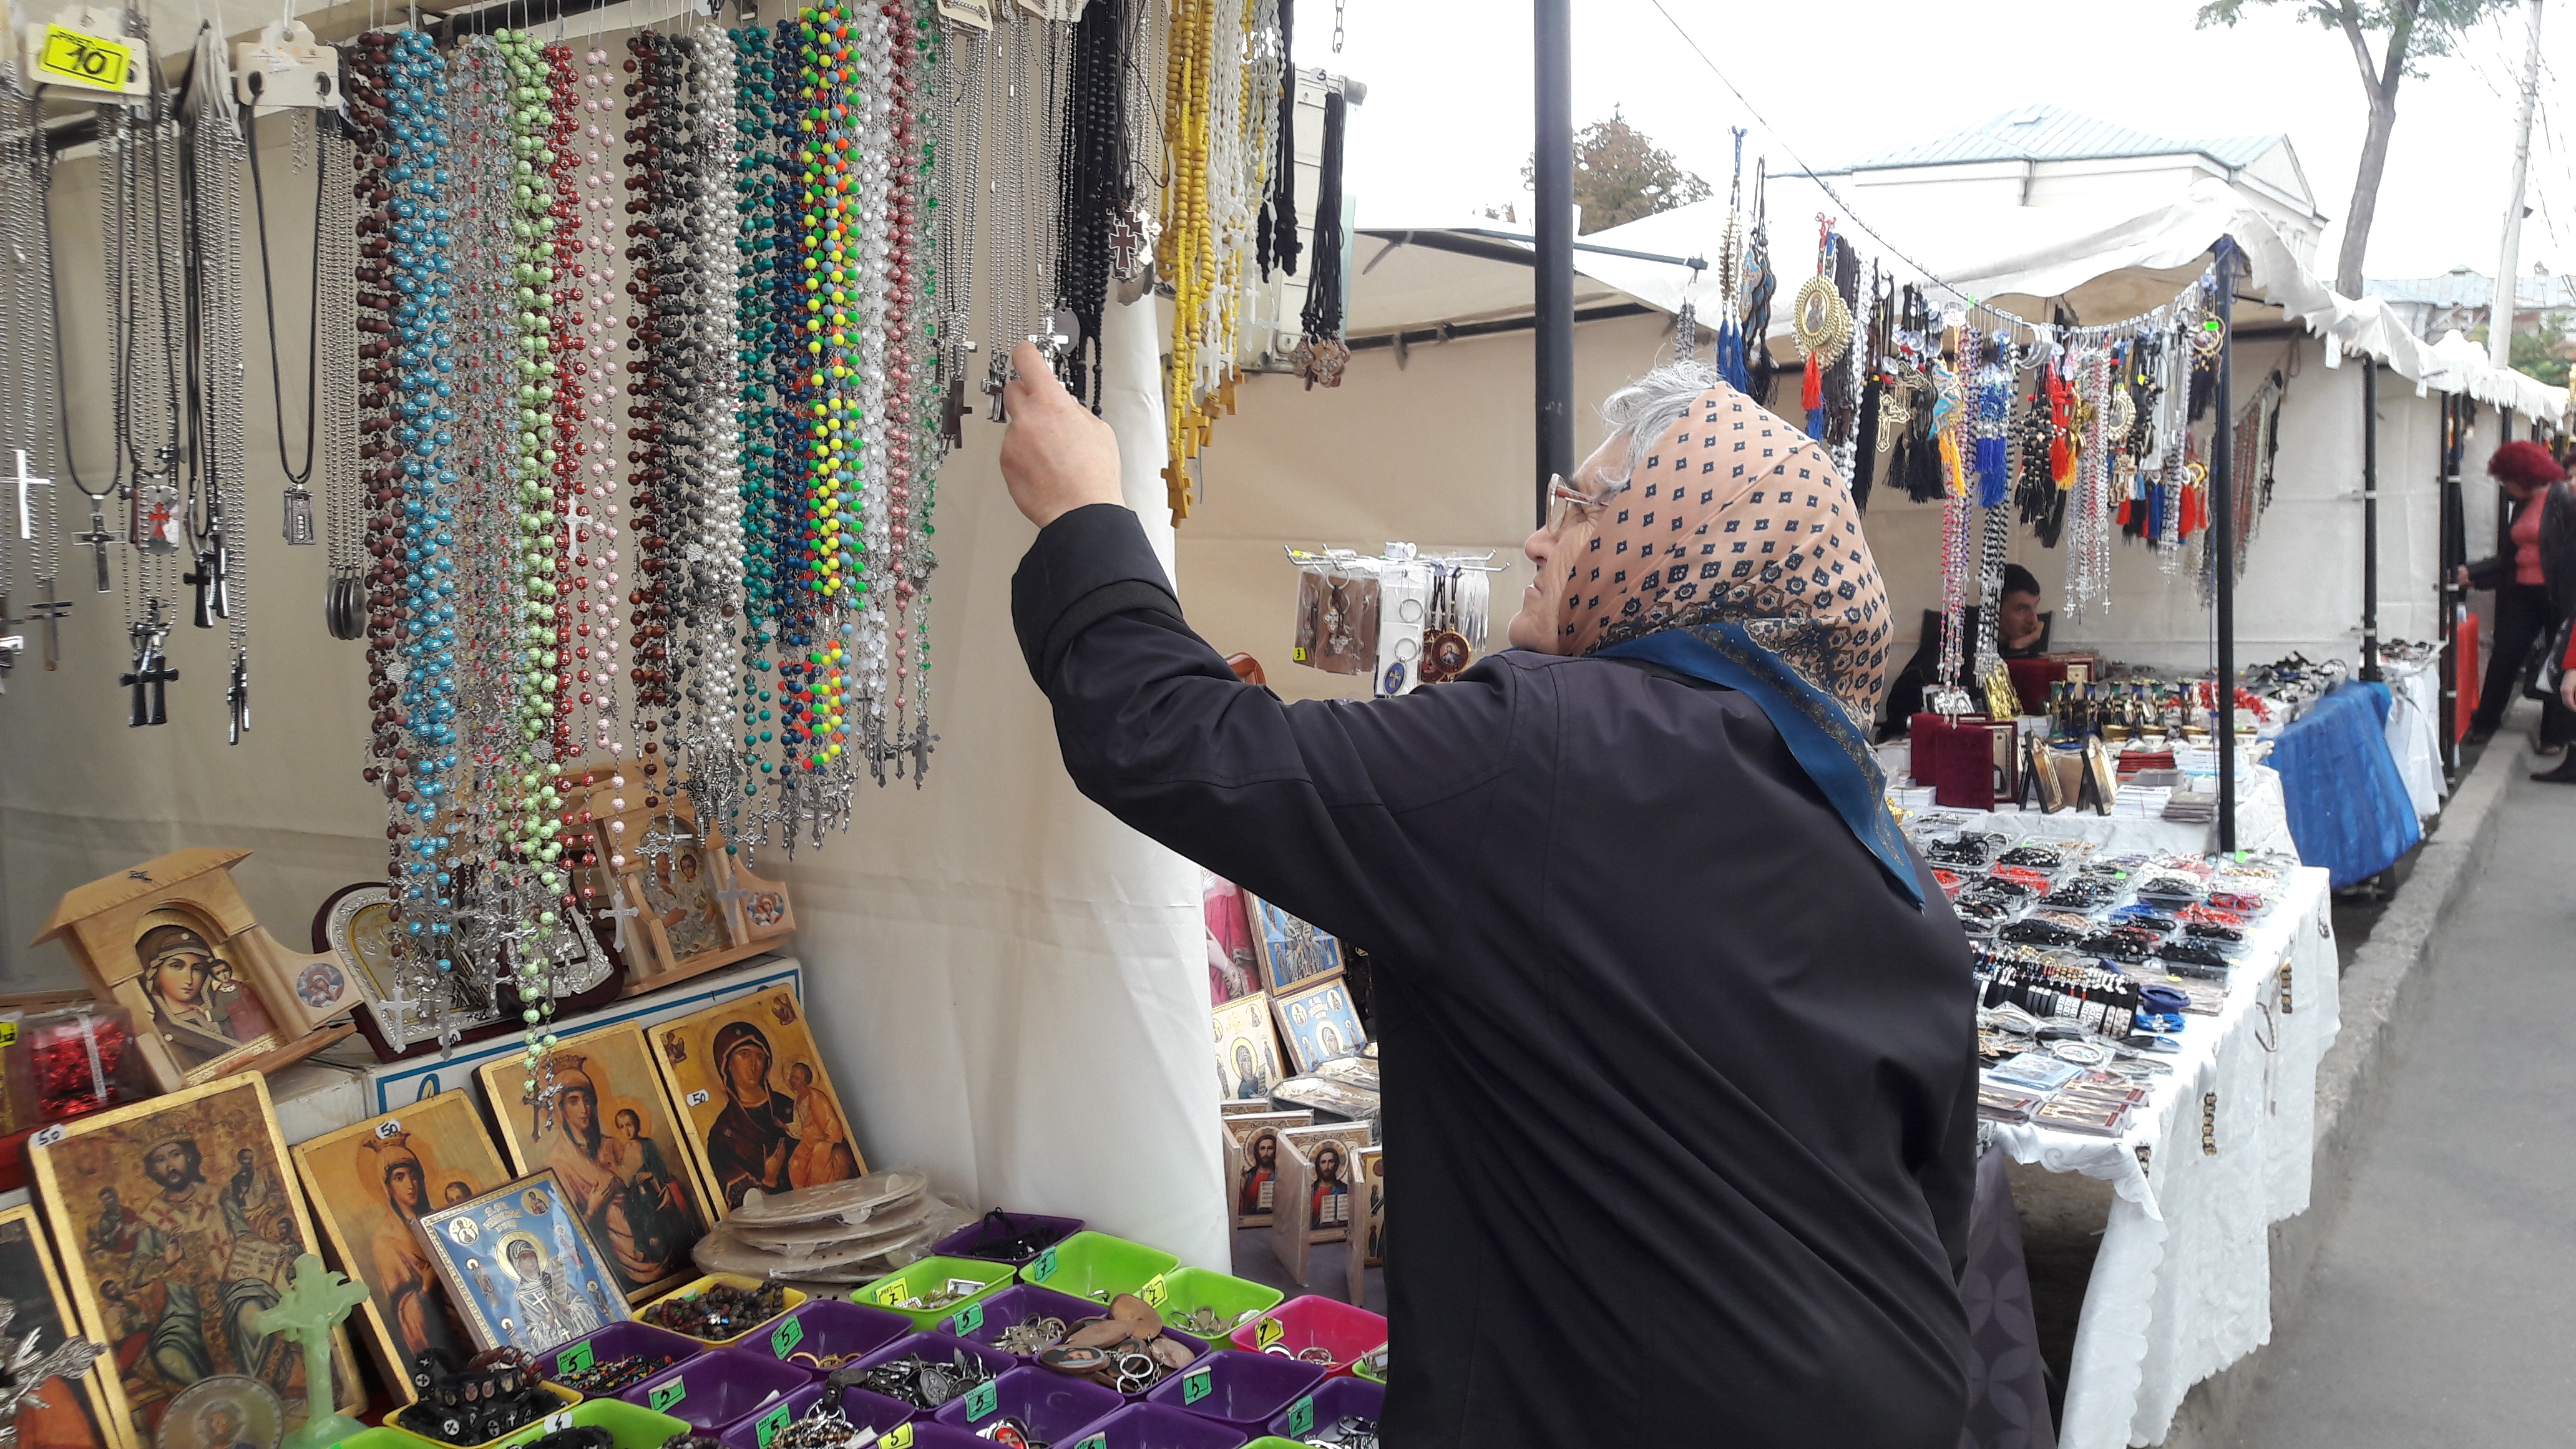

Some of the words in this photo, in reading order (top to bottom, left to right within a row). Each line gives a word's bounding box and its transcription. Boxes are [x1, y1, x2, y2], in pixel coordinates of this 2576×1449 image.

[64, 47, 106, 75] 10
[693, 1092, 706, 1105] 50
[38, 1128, 60, 1146] 50
[381, 1121, 398, 1137] 50
[781, 1324, 790, 1347] 5
[567, 1354, 578, 1373] 5
[1191, 1375, 1199, 1398] 5
[975, 1393, 984, 1412] 5
[769, 1417, 779, 1440] 5
[891, 1430, 899, 1447] 5
